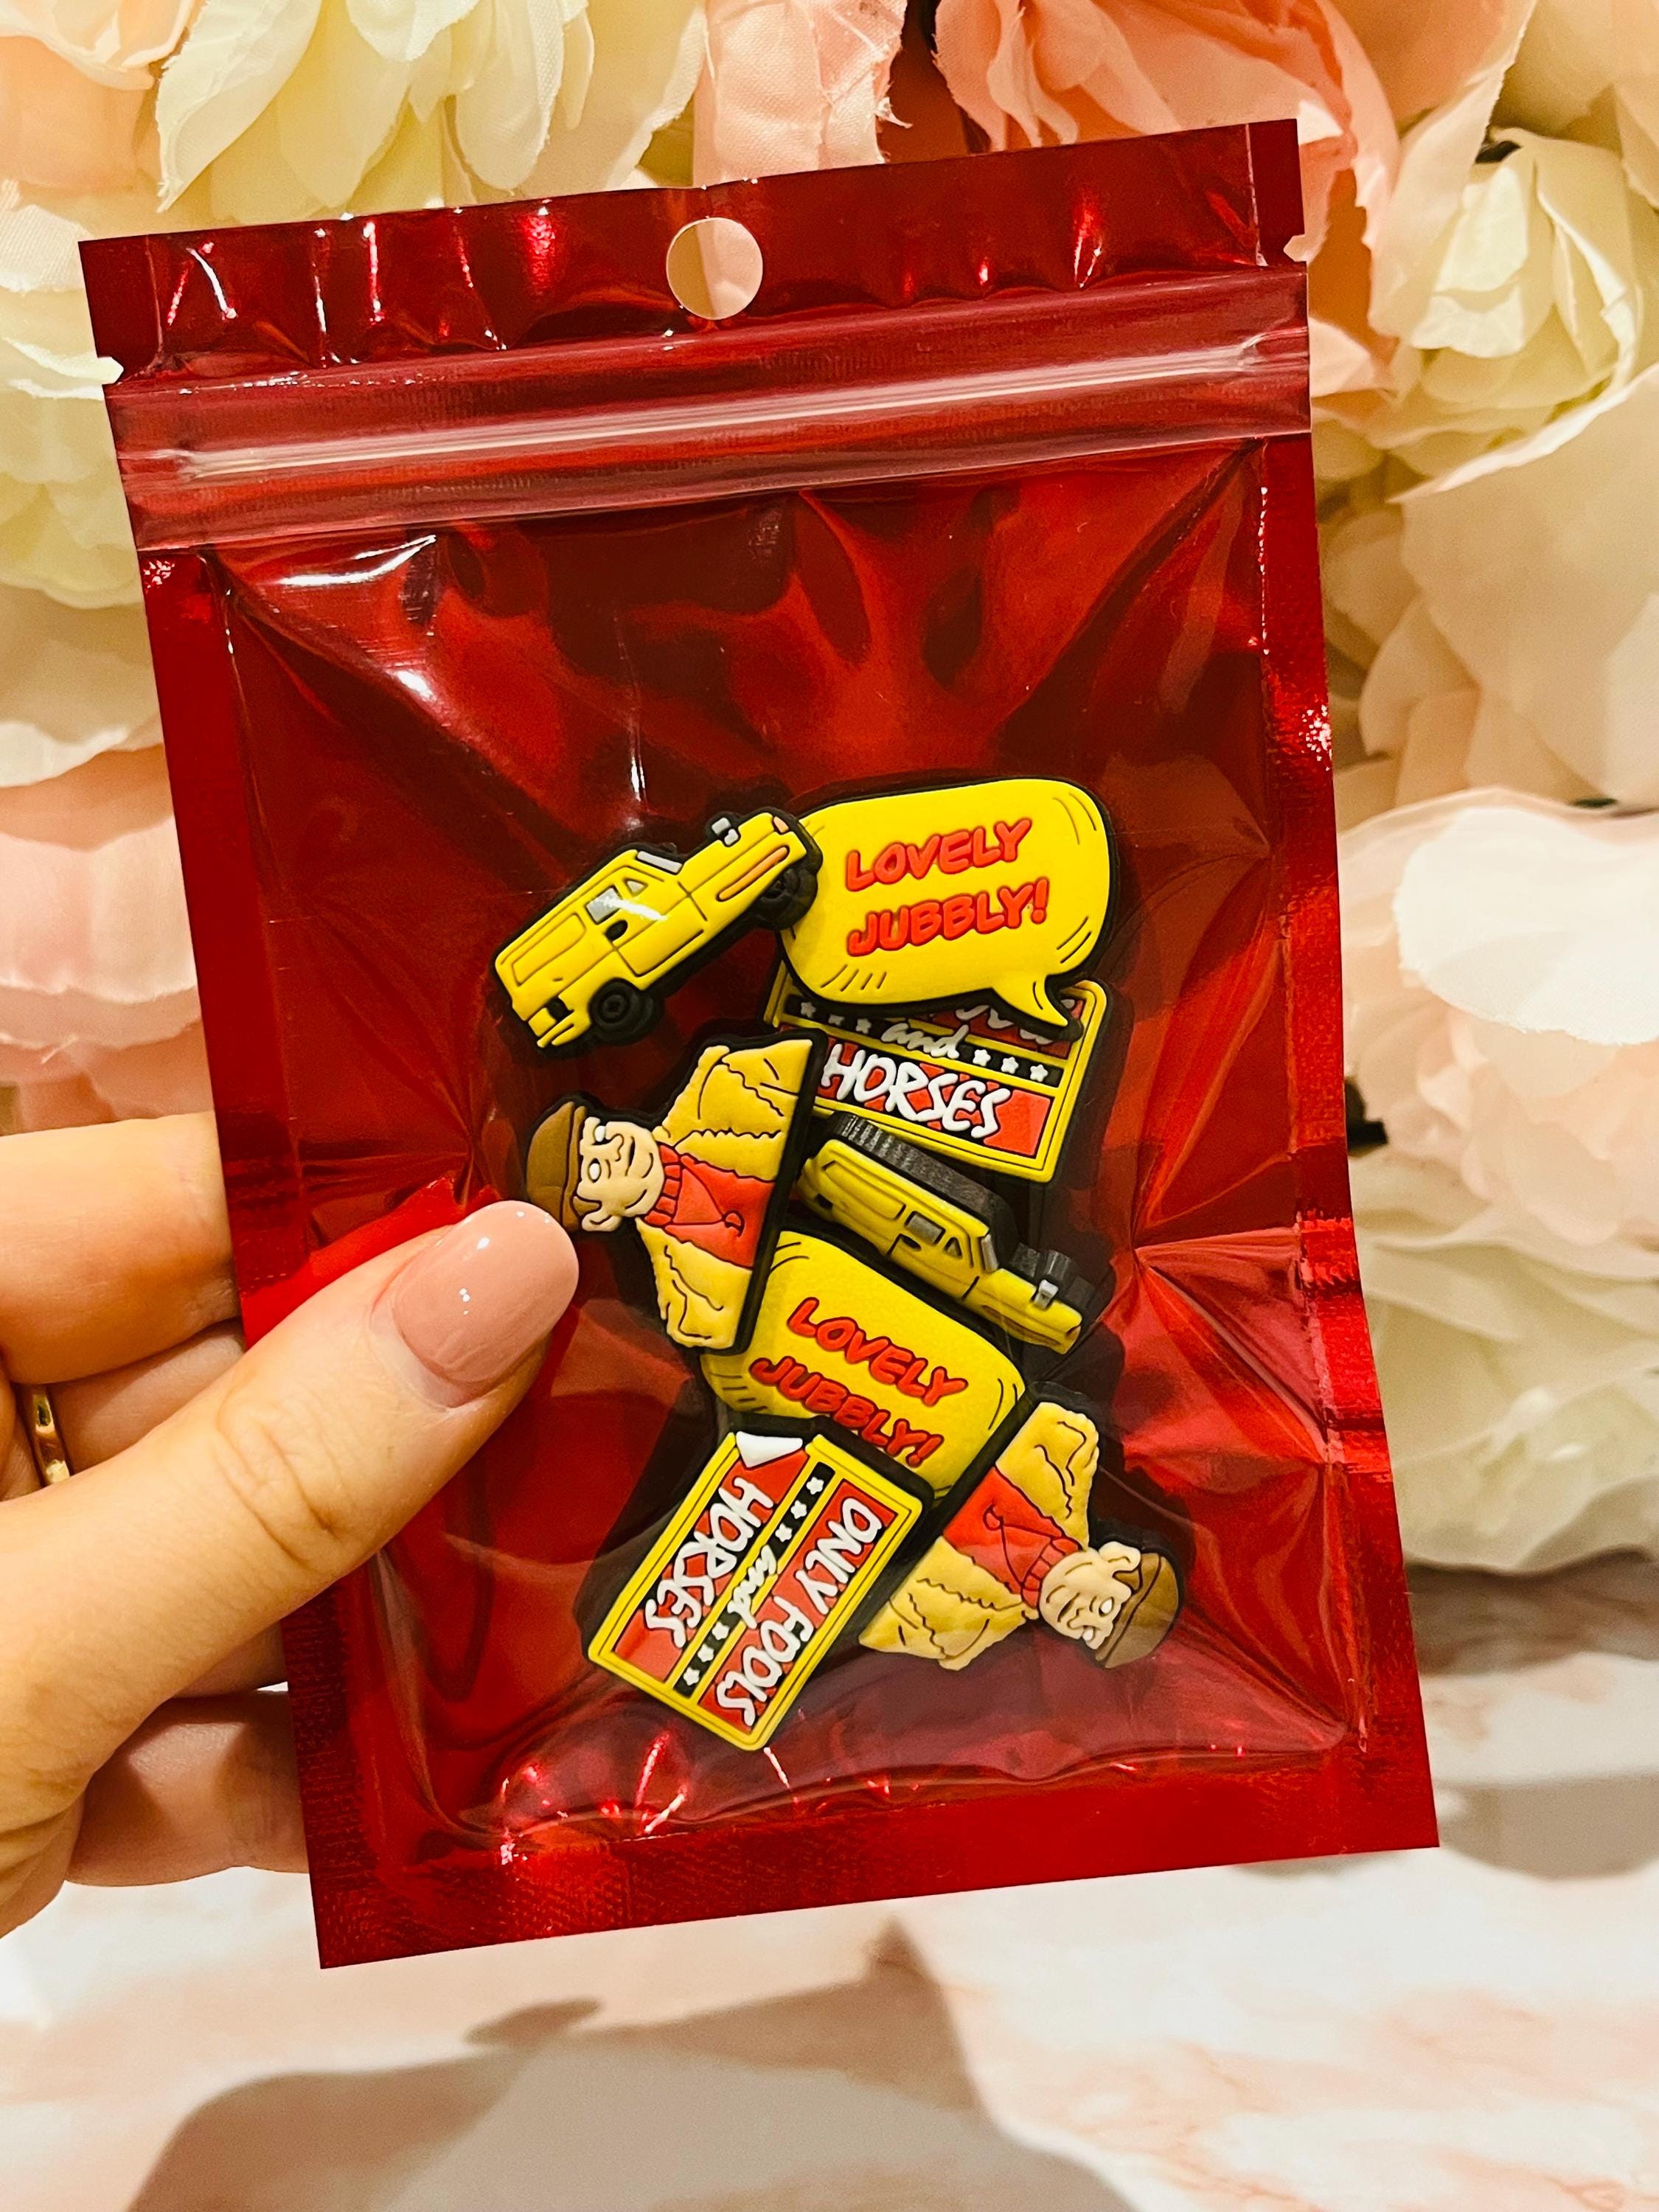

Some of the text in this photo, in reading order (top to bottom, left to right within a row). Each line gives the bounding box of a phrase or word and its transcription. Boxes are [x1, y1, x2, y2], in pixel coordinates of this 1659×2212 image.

[846, 818, 1032, 891] LOVELY
[847, 878, 1049, 956] JUBBLY!
[881, 1023, 970, 1059] and
[821, 1044, 1011, 1138] HORSES
[787, 1298, 967, 1406] LOVELY
[750, 1357, 943, 1467] JUBBLY!
[644, 1477, 774, 1648] HORSES
[727, 1545, 776, 1630] and
[717, 1498, 883, 1726] ONLY FOOLS
